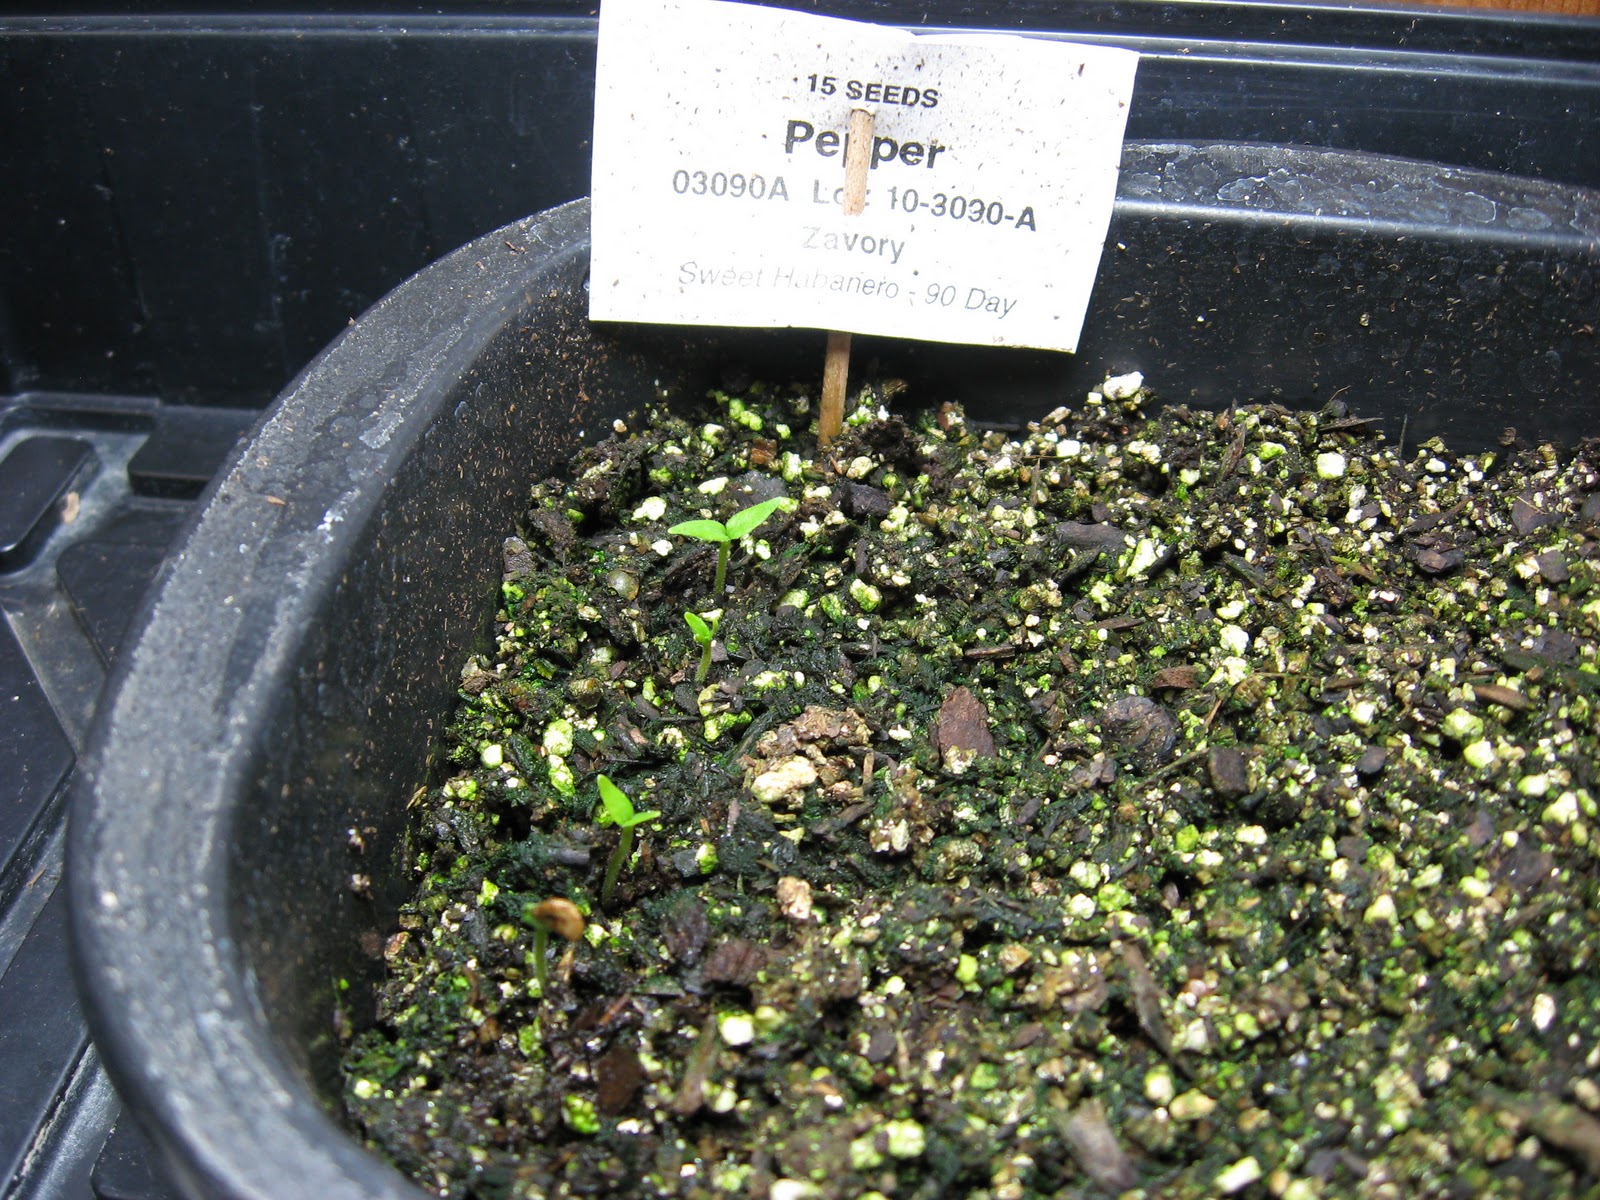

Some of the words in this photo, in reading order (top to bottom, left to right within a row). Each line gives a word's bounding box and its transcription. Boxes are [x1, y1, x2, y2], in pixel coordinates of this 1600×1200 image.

[808, 73, 837, 96] 15
[845, 79, 939, 109] SEEDS
[785, 119, 946, 170] Peper
[672, 169, 790, 202] 03090A
[802, 226, 905, 265] Zavory
[678, 260, 762, 288] Sweet
[773, 265, 899, 299] Habanero
[924, 282, 956, 307] 90
[964, 287, 1018, 320] Day
